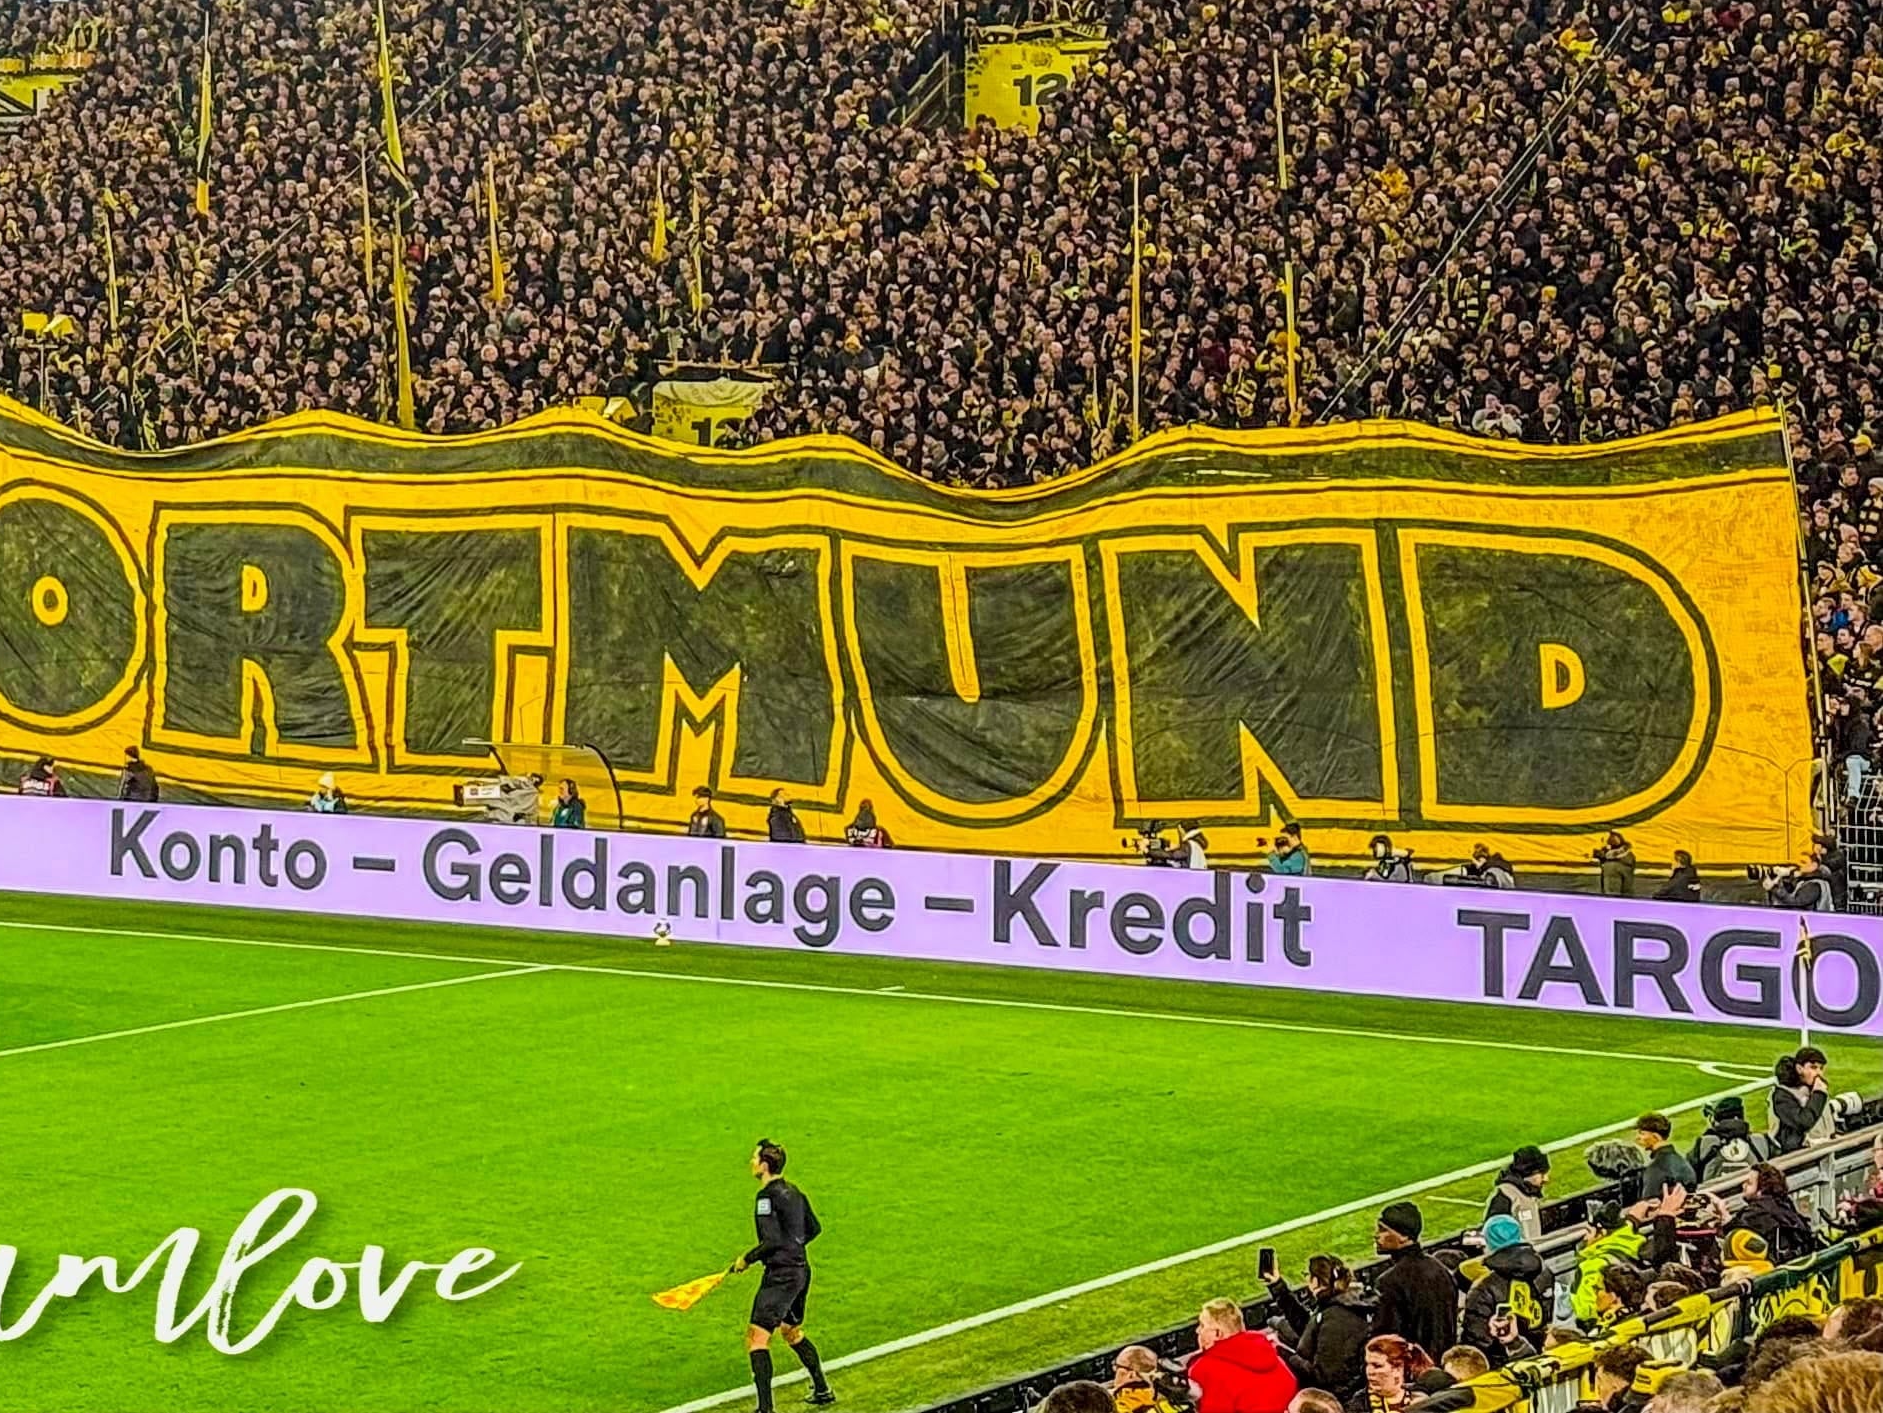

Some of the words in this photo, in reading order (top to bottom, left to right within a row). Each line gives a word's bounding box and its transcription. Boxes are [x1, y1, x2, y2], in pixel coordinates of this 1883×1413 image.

[1012, 72, 1070, 107] 12
[109, 807, 329, 891] Konto
[422, 828, 896, 948] Geldanlage
[992, 857, 1313, 968] Kredit
[1457, 907, 1881, 1029] TARGO
